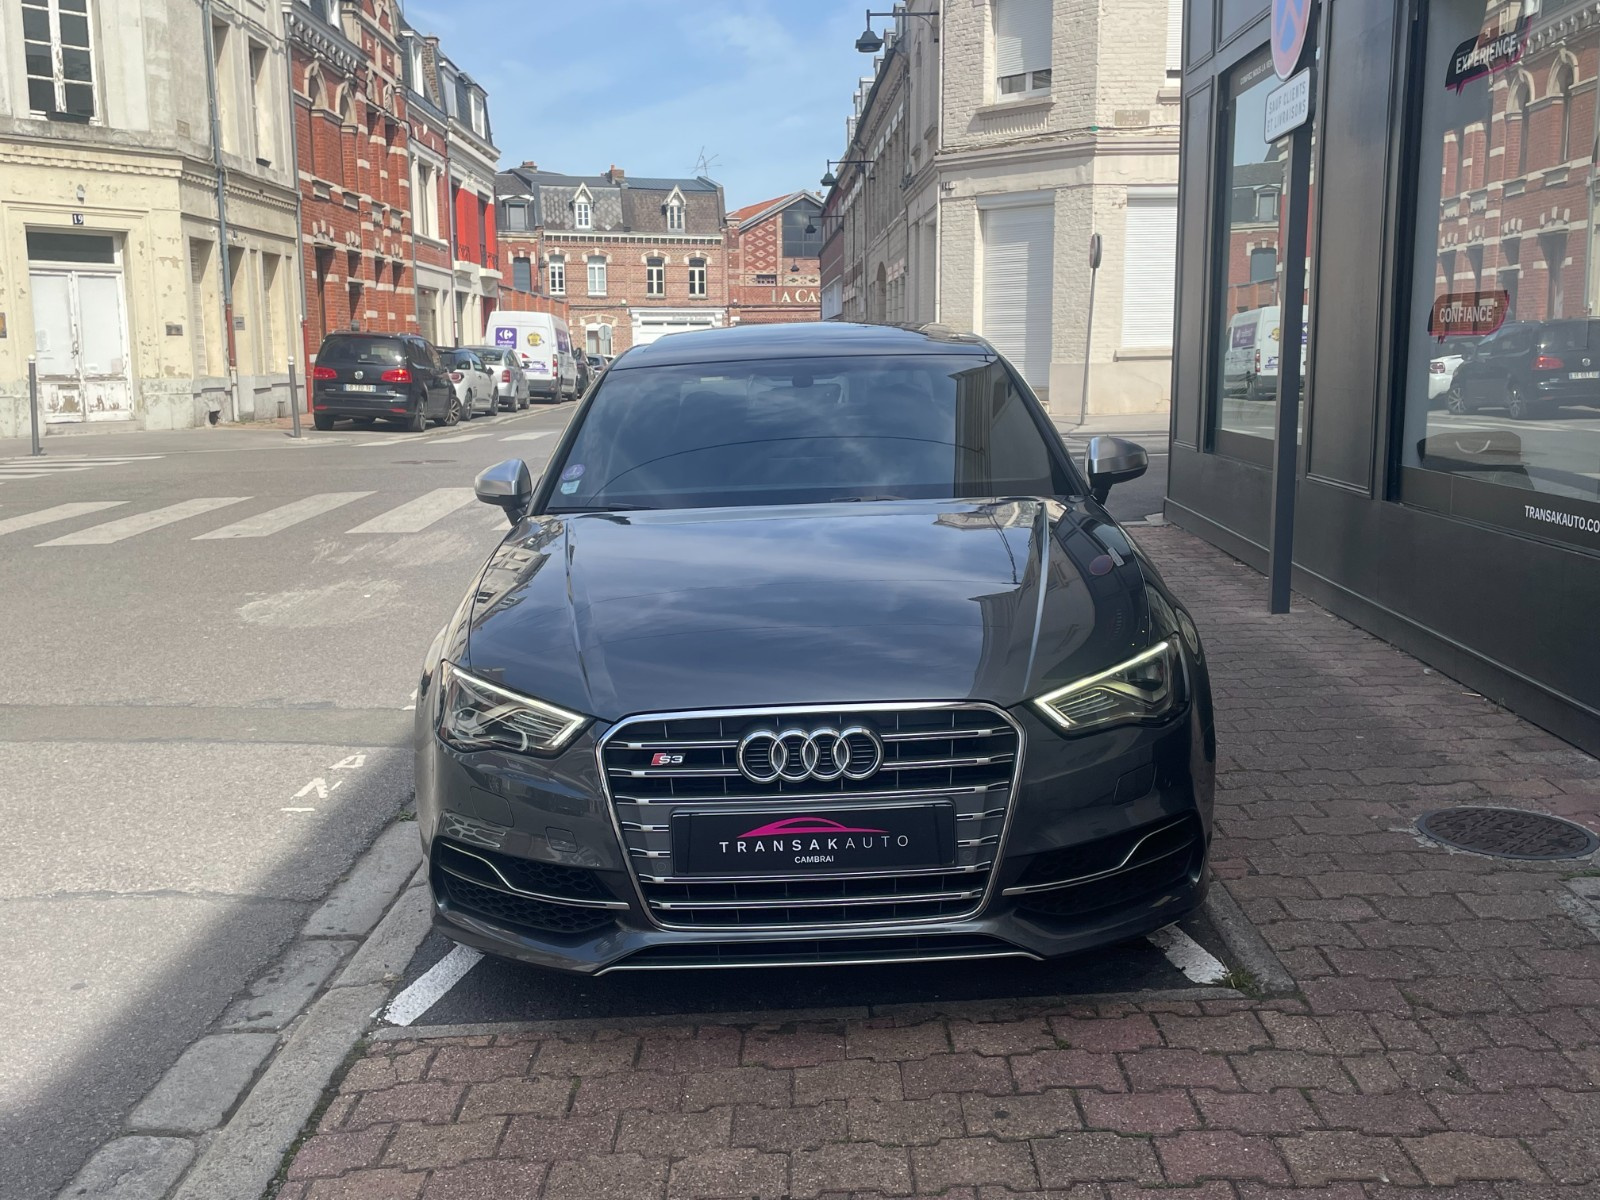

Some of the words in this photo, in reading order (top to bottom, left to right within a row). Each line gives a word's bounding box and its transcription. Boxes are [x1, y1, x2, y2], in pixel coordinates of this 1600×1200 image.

[1456, 34, 1517, 74] EXPERIENCE
[1269, 96, 1281, 114] SAUF
[1283, 81, 1306, 106] CLIENTS
[1267, 117, 1273, 133] ET
[1274, 99, 1306, 129] LIVRAISONS
[73, 214, 83, 224] 19
[1440, 306, 1493, 323] CONFIANCE
[1524, 505, 1600, 533] TRANSAKAUTO.CO
[658, 755, 684, 764] S3
[794, 855, 834, 864] CAMBRAI
